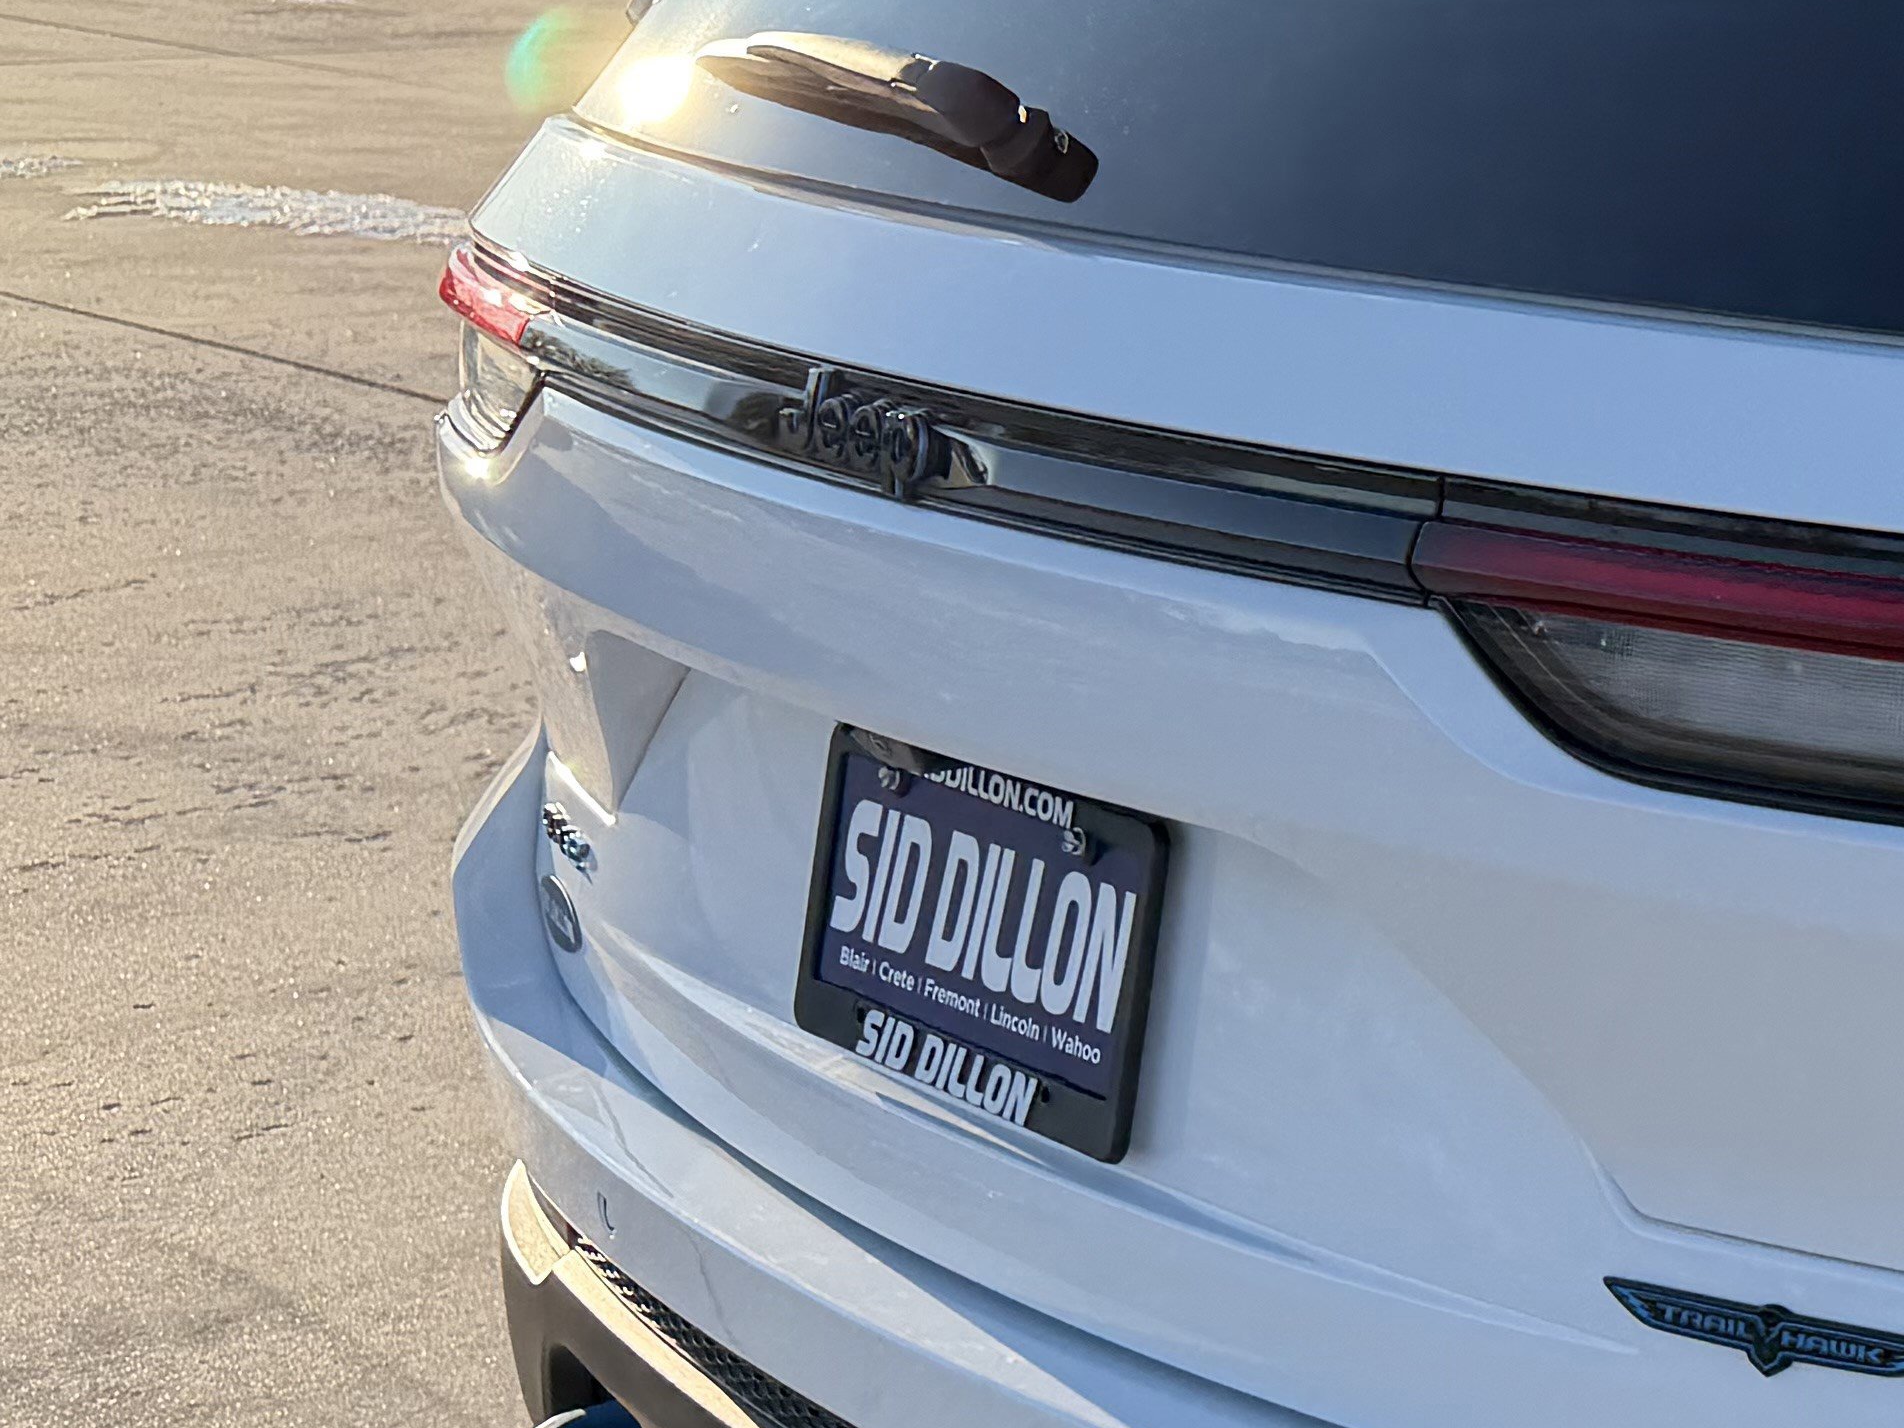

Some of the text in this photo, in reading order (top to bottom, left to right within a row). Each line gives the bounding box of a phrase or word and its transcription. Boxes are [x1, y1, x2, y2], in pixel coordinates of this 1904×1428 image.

[778, 365, 929, 499] Jeep
[829, 799, 1137, 1034] SID DILLON
[839, 945, 1102, 1065] Blair Crete Fremont Lincoln Wahoo
[855, 1009, 1039, 1127] SID DILLON
[1655, 1302, 1885, 1365] TRAIL HAWK
